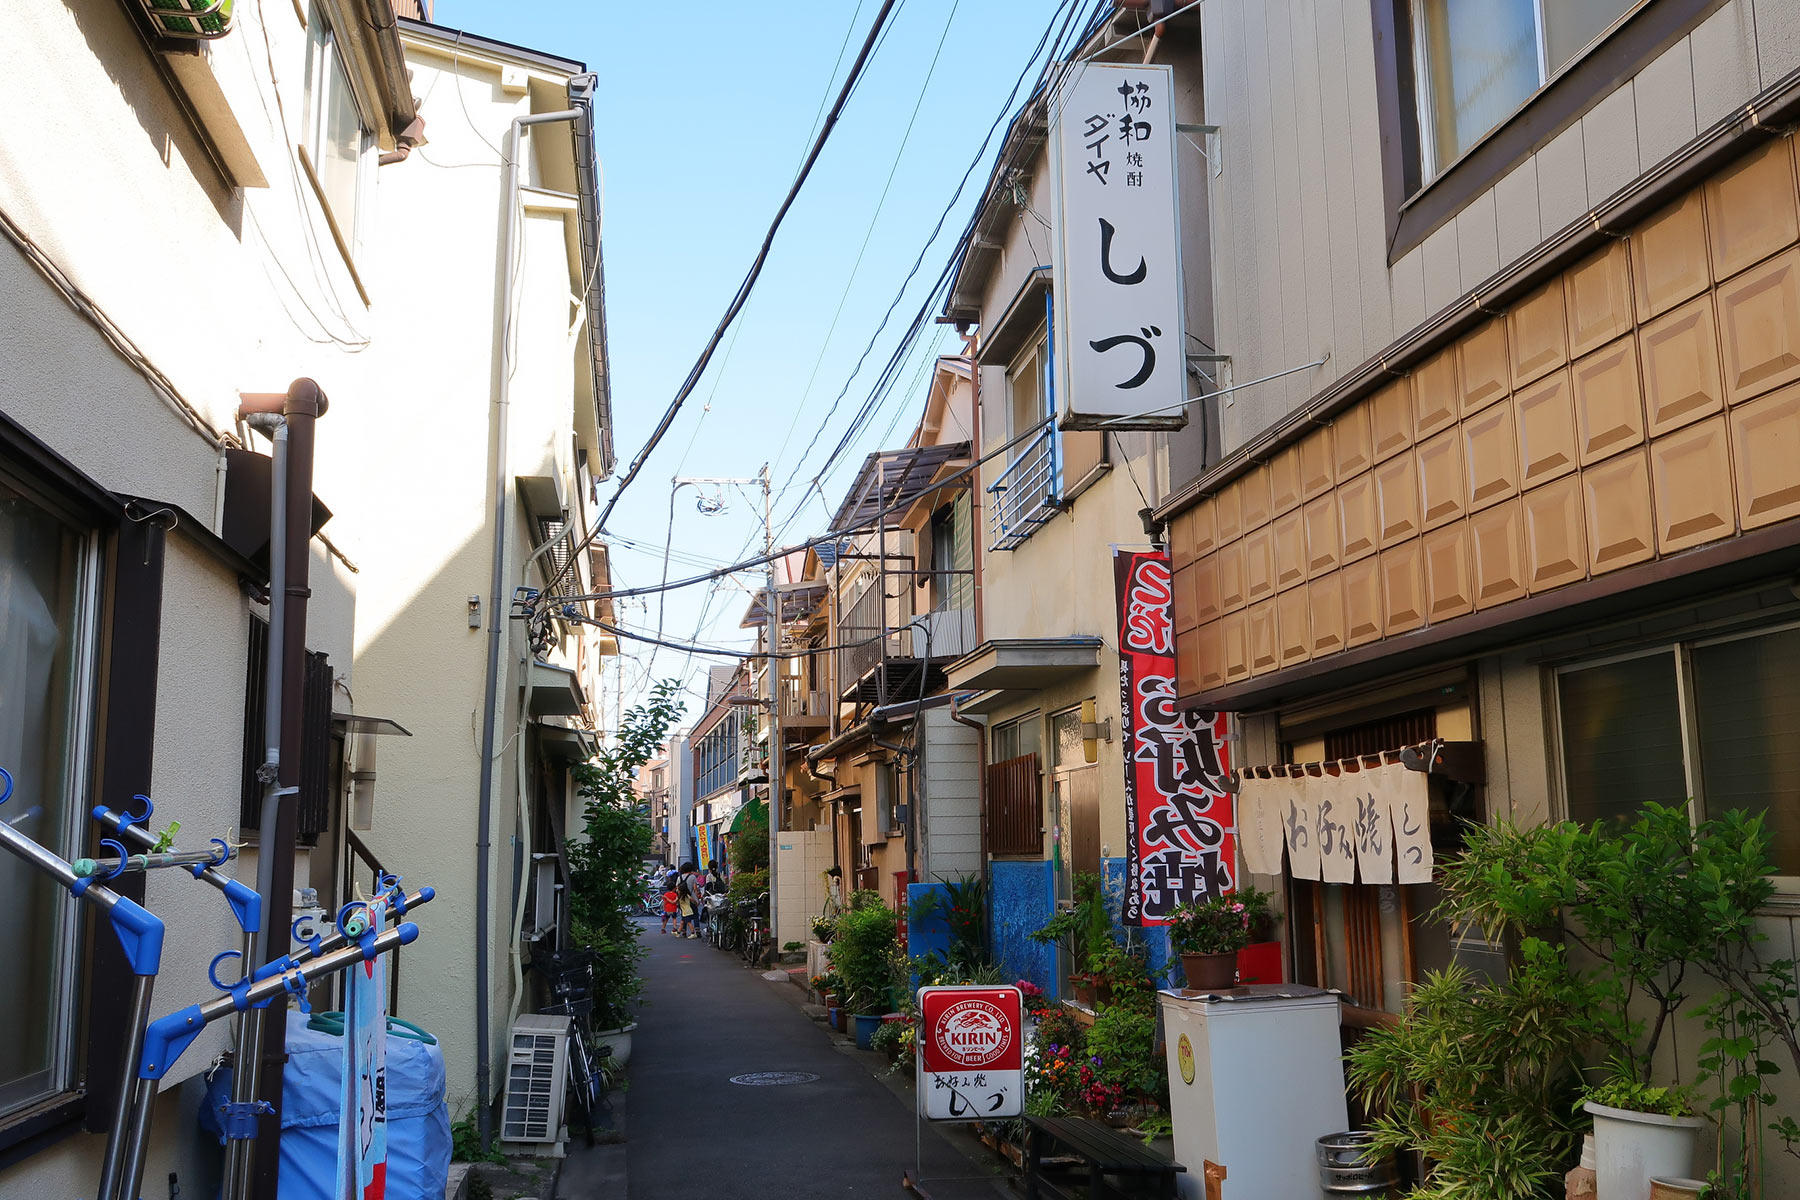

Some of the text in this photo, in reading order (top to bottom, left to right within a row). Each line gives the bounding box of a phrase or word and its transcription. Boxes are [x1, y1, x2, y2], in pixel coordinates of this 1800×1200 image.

[1083, 113, 1116, 186] ダイヤ
[1117, 79, 1152, 188] 協和 焼酎
[1088, 217, 1163, 390] しづ
[941, 1008, 956, 1024] KIRIN
[956, 1002, 984, 1012] BREWERY
[951, 1032, 997, 1045] KIRIN
[949, 1086, 1008, 1117] しづ
